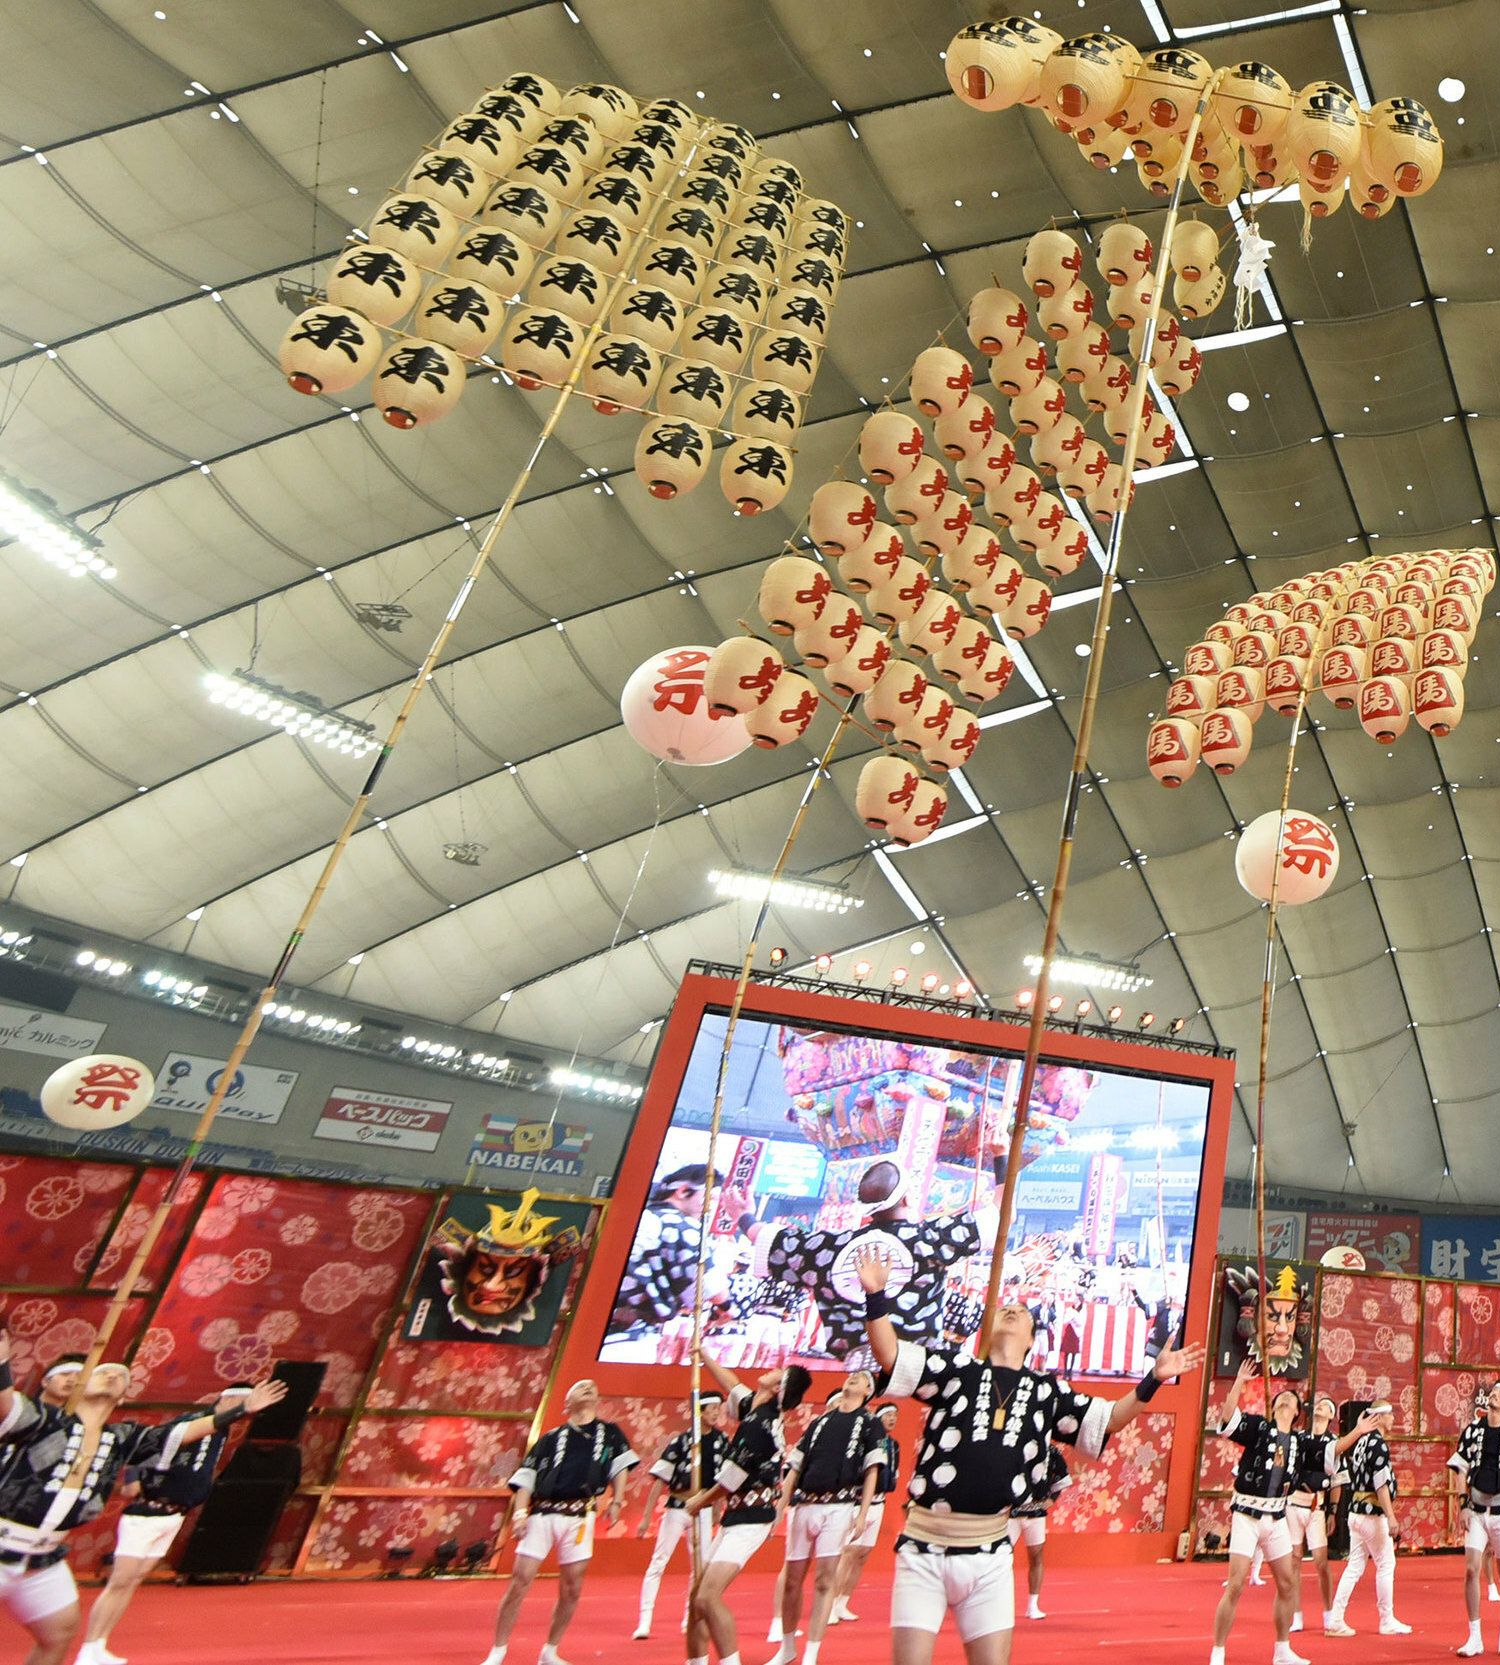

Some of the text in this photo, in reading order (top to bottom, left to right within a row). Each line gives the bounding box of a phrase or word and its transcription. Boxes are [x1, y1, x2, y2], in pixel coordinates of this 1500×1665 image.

[1283, 817, 1334, 879] 祭
[29, 1031, 95, 1049] カルミック
[74, 1064, 141, 1111] 祭
[156, 1145, 224, 1165] DUKIN
[1309, 1228, 1376, 1247] ニッタン
